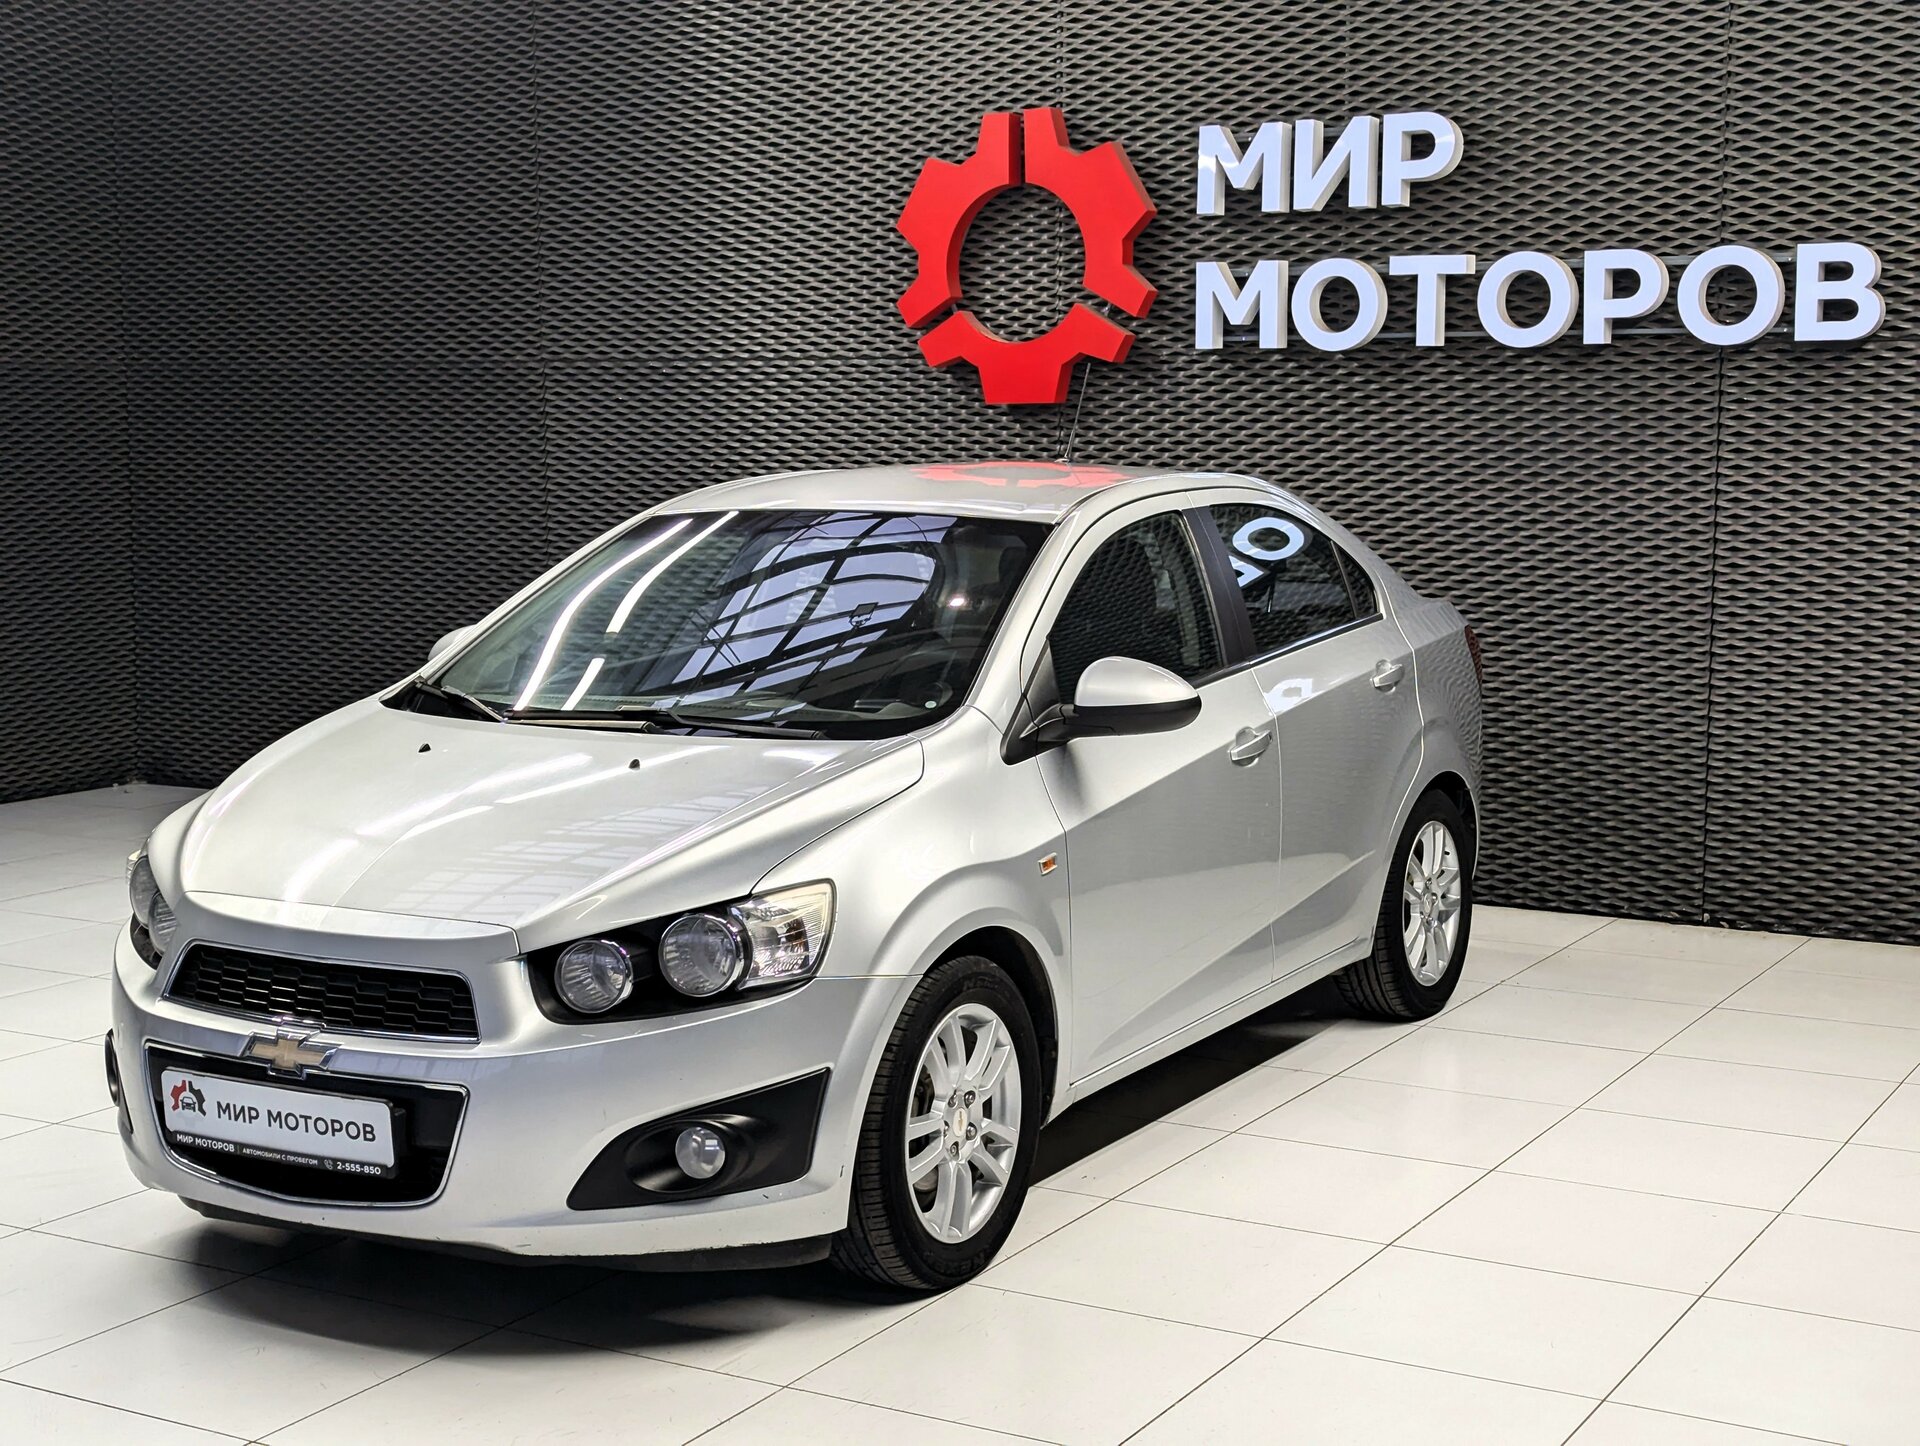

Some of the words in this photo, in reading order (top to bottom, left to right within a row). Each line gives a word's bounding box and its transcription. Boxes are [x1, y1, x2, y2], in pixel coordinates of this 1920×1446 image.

[1197, 111, 1463, 216] МИР
[1195, 242, 1885, 351] МОТОРОВ
[176, 1134, 193, 1144] МИР
[195, 1138, 235, 1152] МОТОРОВ
[242, 1148, 281, 1160] АВТОМОБИЛИ
[287, 1155, 318, 1166] ПРОБЕГОМ
[337, 1161, 381, 1175] 2-555-850
[216, 1101, 260, 1124] МИР
[267, 1109, 376, 1142] МОТОРОВ
